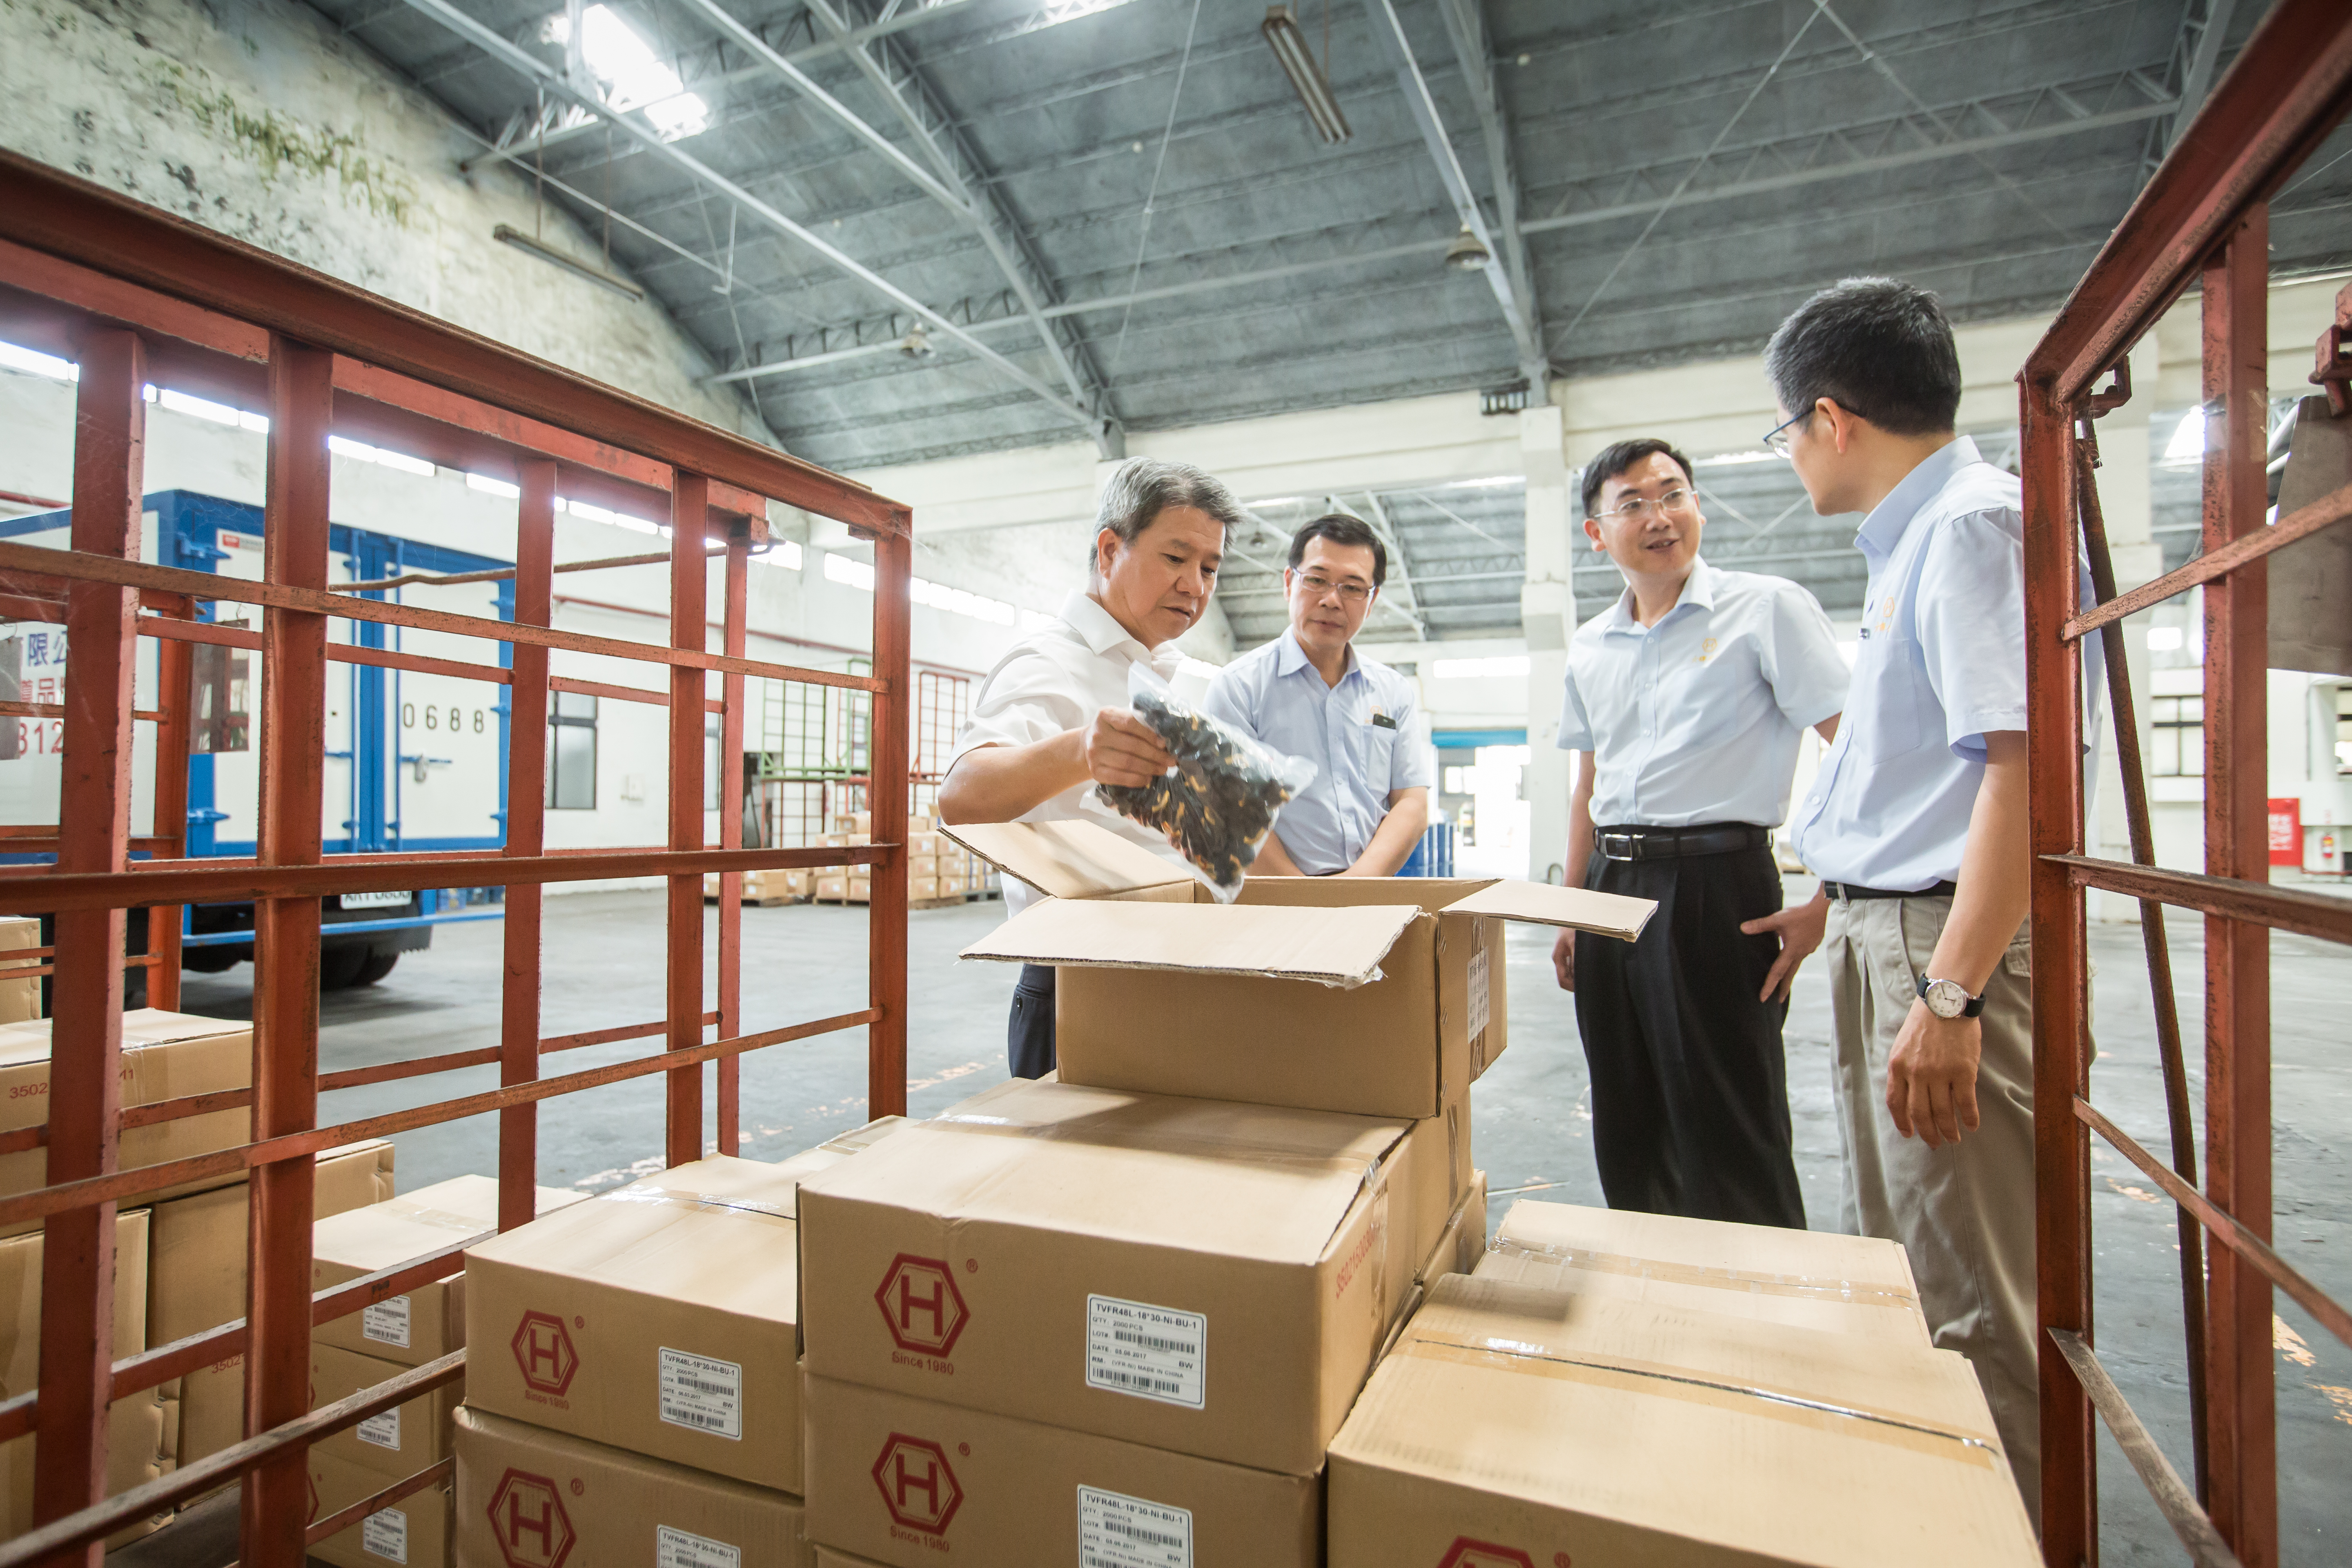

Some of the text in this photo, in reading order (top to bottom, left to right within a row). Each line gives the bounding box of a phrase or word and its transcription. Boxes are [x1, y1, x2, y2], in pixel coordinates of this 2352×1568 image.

[403, 703, 484, 733] 0688
[9, 1082, 48, 1099] 3502
[901, 1274, 943, 1337] H
[530, 1328, 559, 1379] H
[892, 1350, 954, 1375] Since 1980
[1178, 1360, 1193, 1370] BW
[1138, 1365, 1155, 1373] MADE
[1165, 1370, 1183, 1378] CHINA
[896, 1453, 938, 1515] H
[510, 1492, 551, 1557] H
[890, 1525, 920, 1545] Since
[1167, 1553, 1181, 1563] BW
